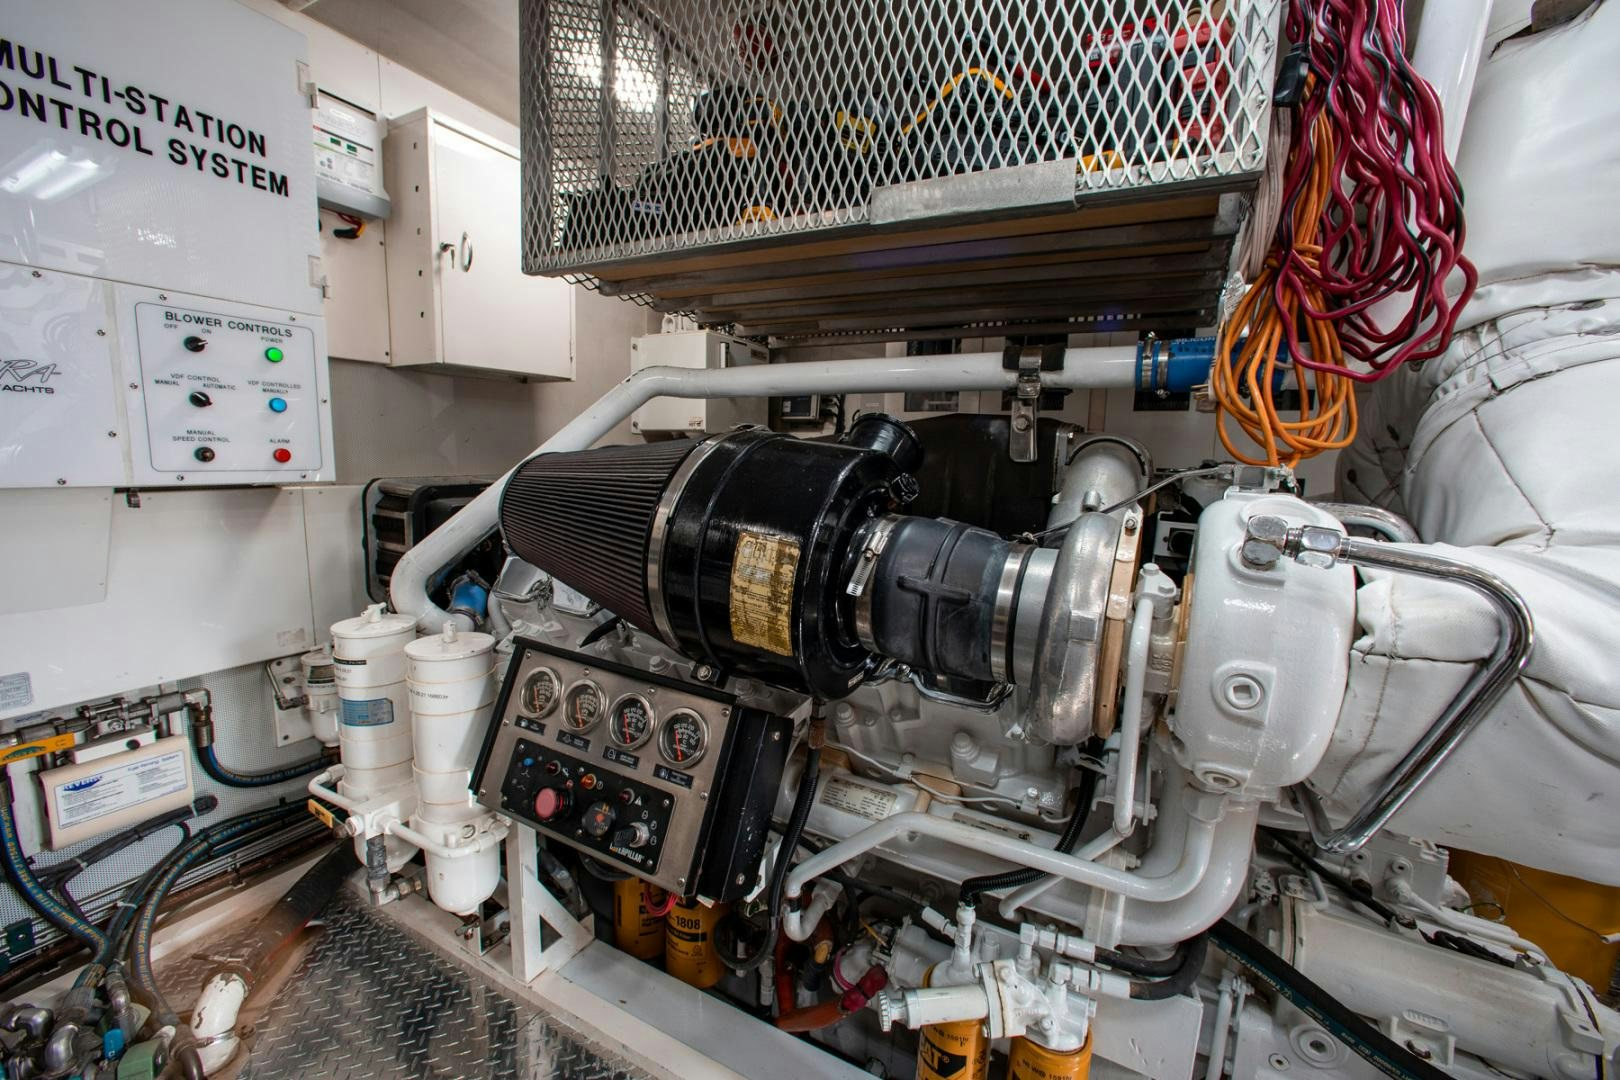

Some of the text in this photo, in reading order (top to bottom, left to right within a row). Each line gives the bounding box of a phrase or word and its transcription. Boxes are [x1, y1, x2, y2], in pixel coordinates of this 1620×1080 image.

[0, 38, 266, 158] MULTI-STATION
[0, 80, 153, 156] ONTROL
[168, 138, 289, 197] SYSTEM
[165, 311, 293, 338] BLOWER CONTROLS
[261, 336, 283, 344] POWER
[187, 374, 220, 383] CONTROL
[0, 384, 55, 394] ACHTS
[202, 383, 236, 391] AUTOMATIC
